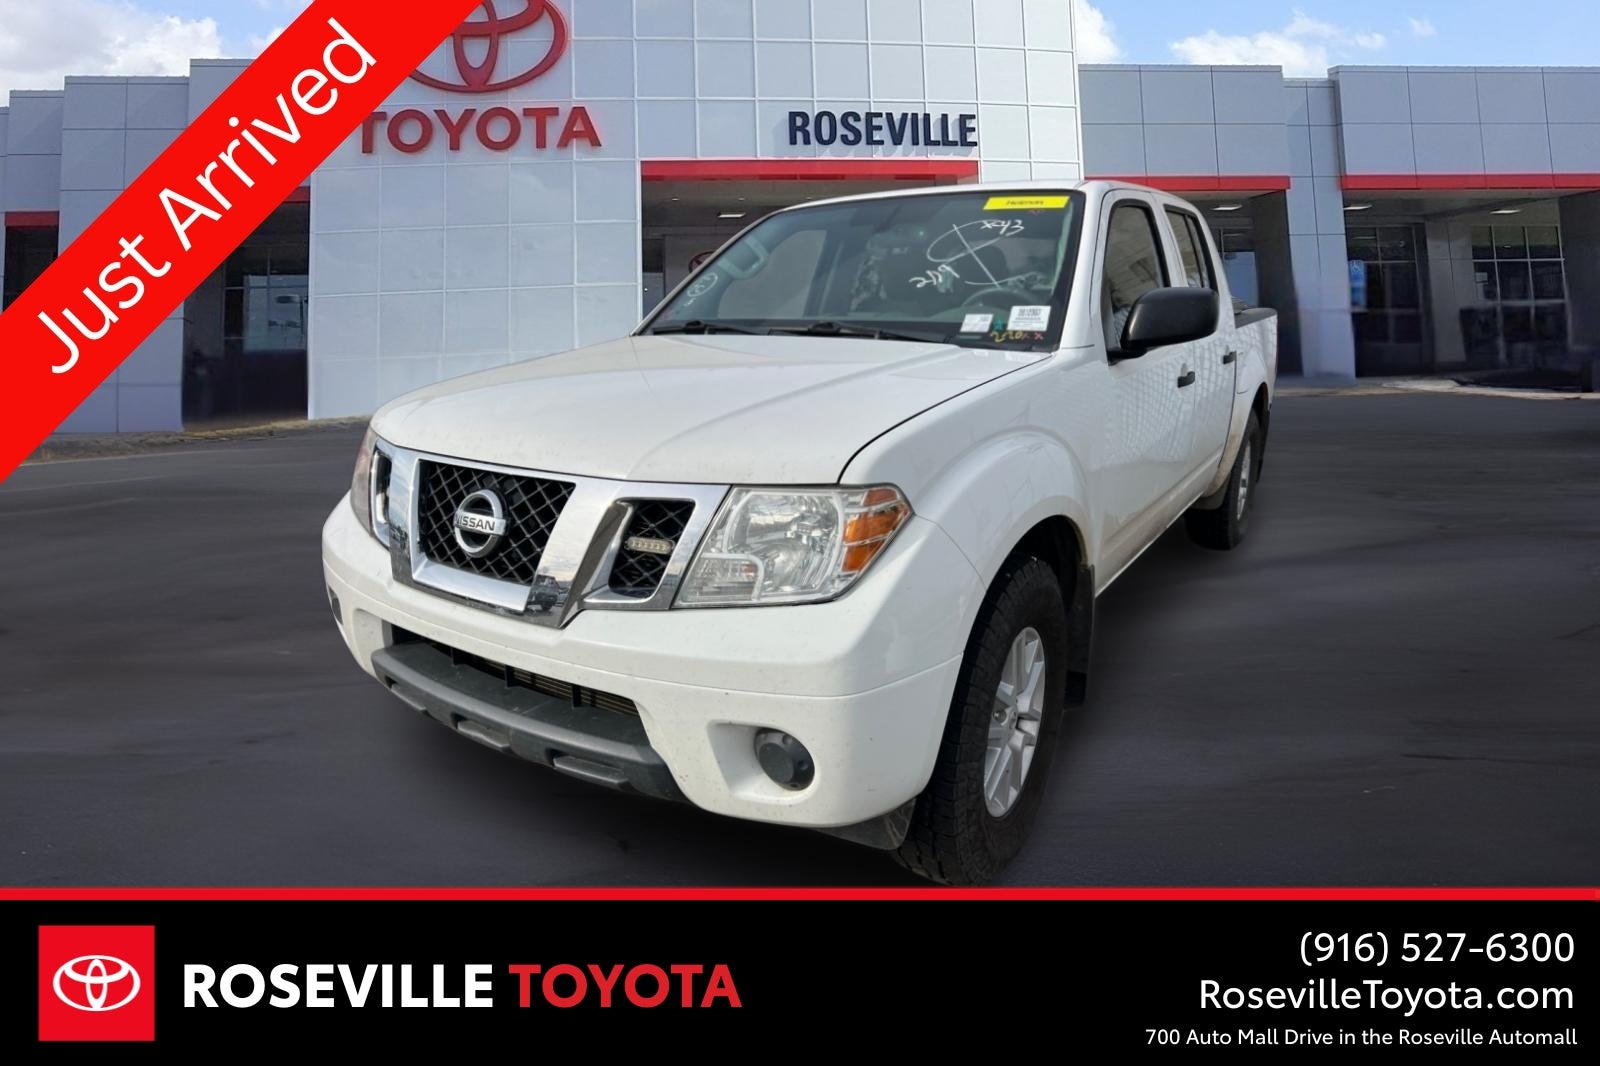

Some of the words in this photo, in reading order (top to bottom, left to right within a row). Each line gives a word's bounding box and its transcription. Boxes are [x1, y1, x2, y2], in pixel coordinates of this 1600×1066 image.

[361, 106, 602, 154] TOYOTA
[788, 110, 979, 148] ROSEVILLE
[455, 513, 496, 531] NISSAN
